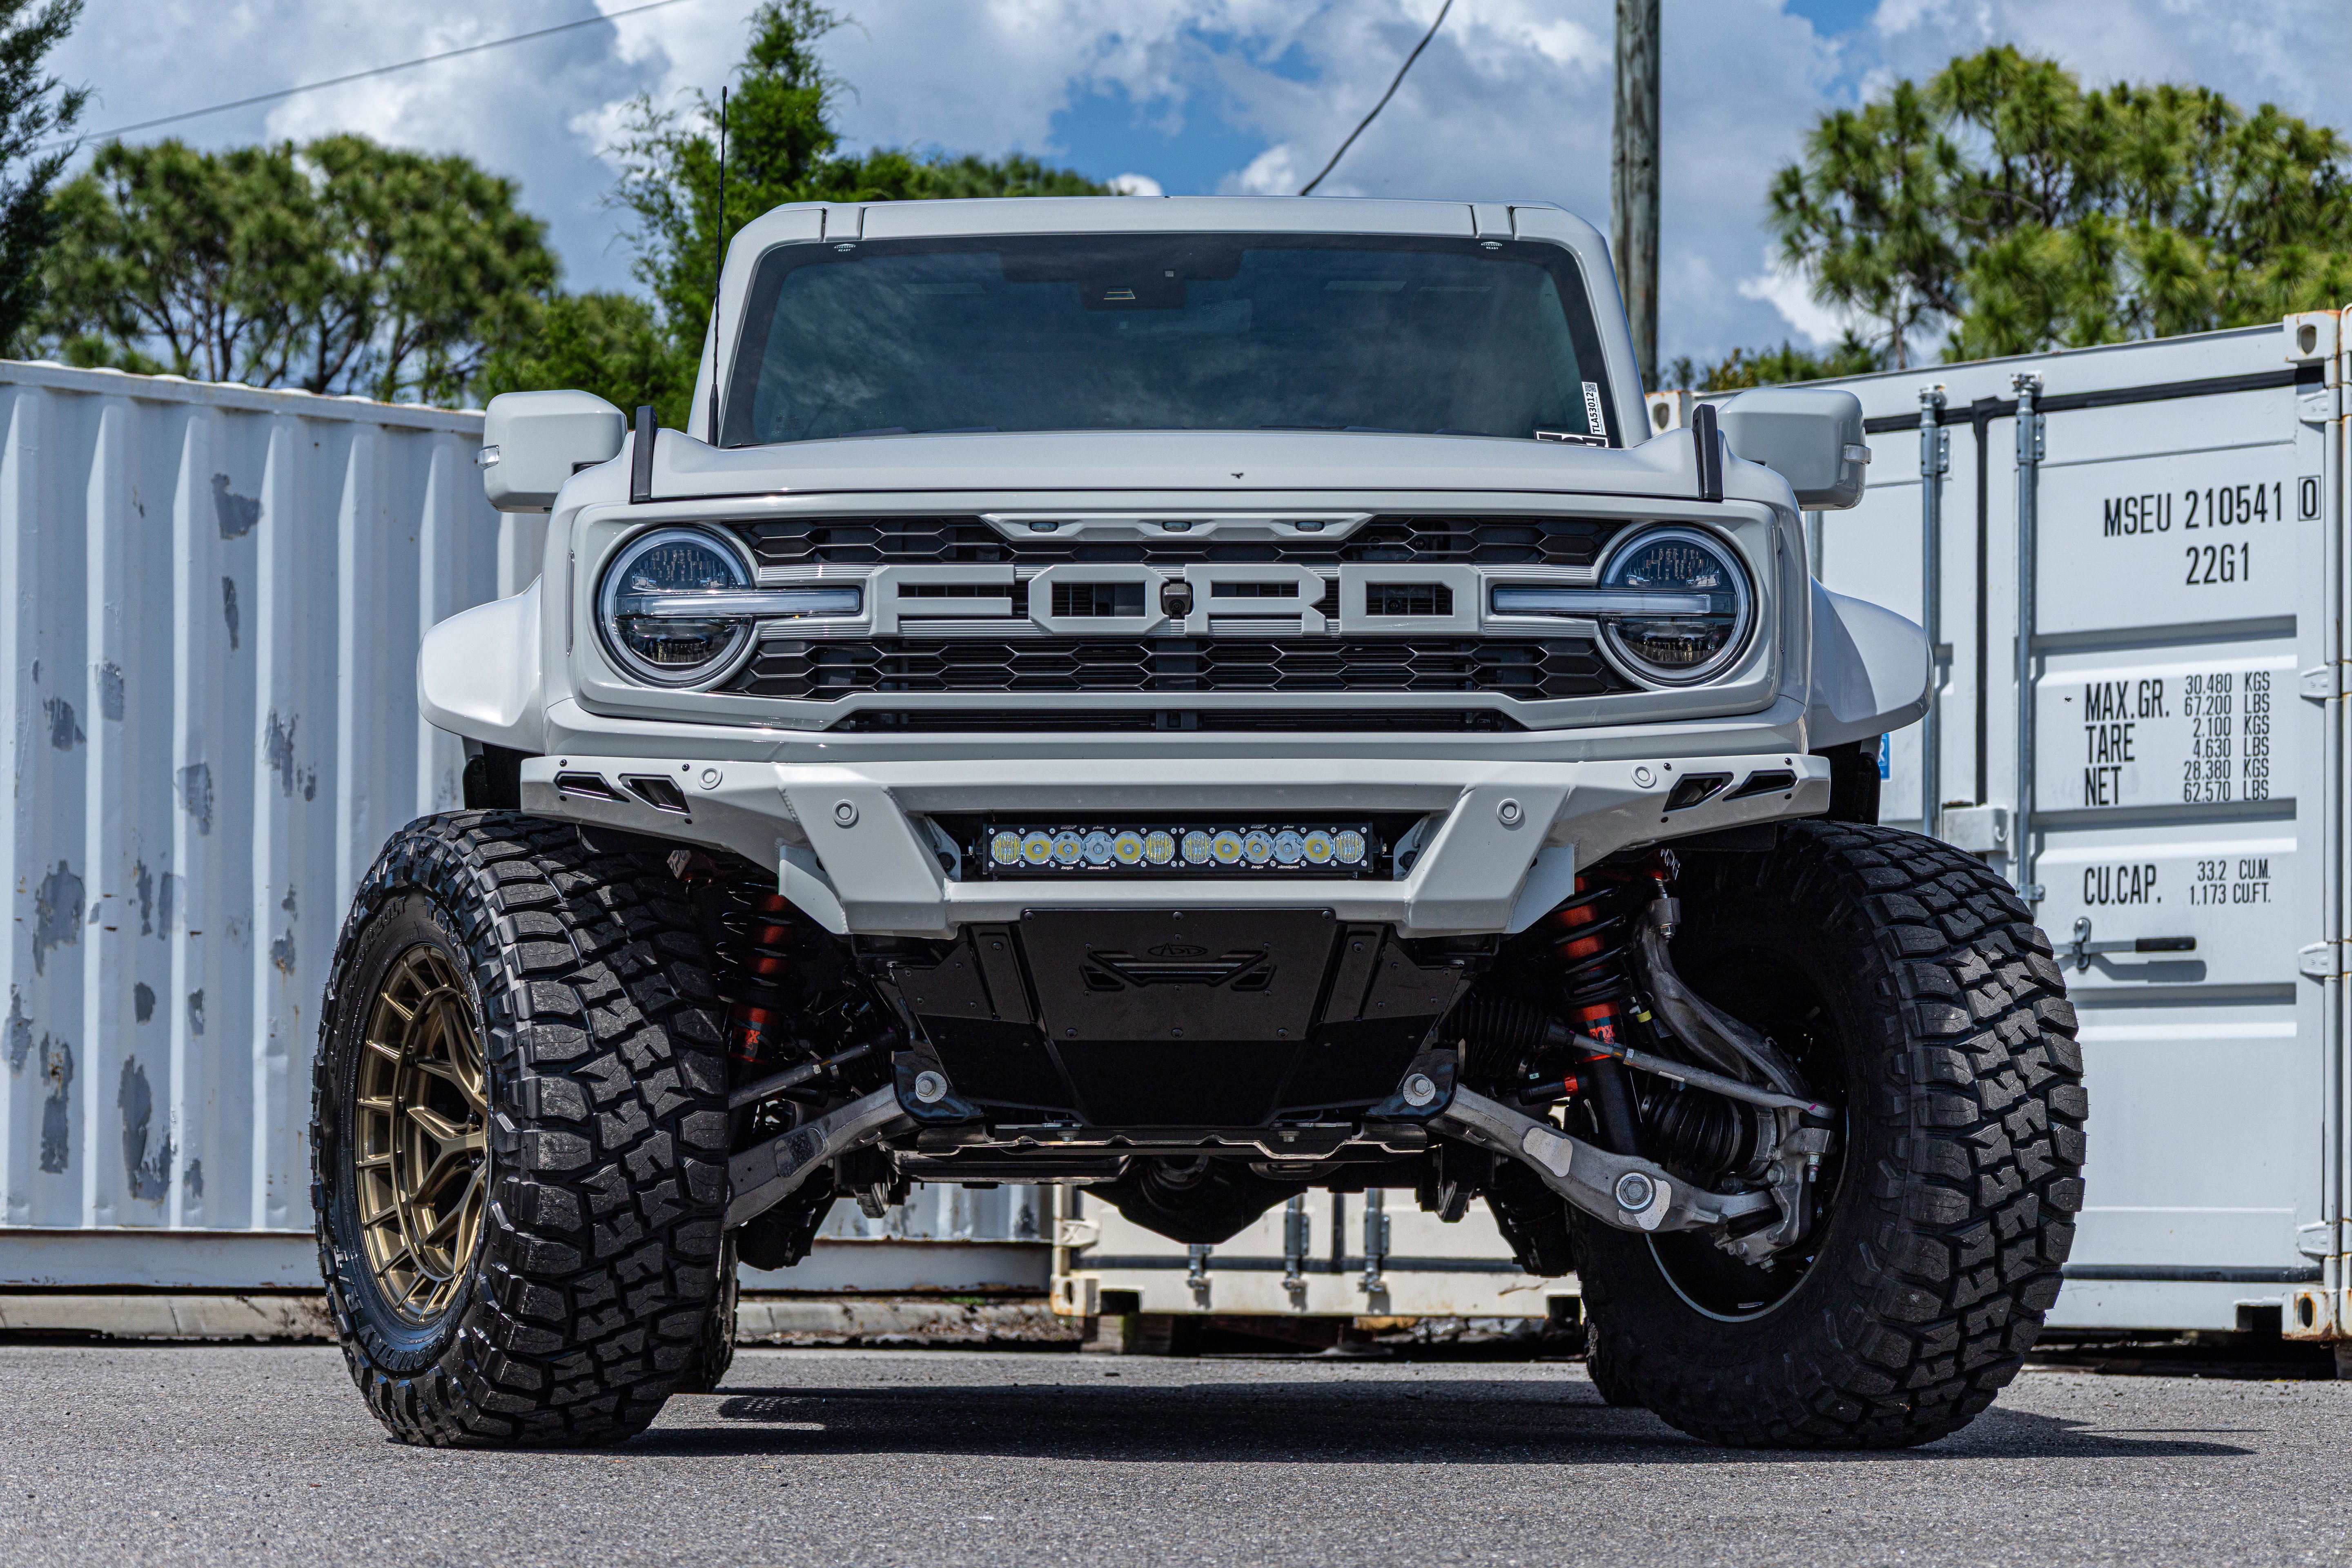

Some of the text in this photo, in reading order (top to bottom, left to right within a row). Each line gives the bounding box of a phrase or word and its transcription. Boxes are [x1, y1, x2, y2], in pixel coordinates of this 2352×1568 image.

[1586, 392, 1600, 433] TLA53012
[2104, 478, 2317, 537] MSEU 210541 0
[2186, 542, 2249, 586] 22G1
[871, 564, 1482, 636] FORD
[2244, 693, 2270, 714] LBS
[2245, 671, 2270, 692] KGS
[2085, 715, 2270, 764] TARE 2,100 KGS
[2244, 736, 2270, 757] LBS
[2085, 766, 2123, 807] NET
[2244, 757, 2270, 778] KGS
[2243, 780, 2269, 801] LBS
[2084, 864, 2161, 906] CU.CAP.
[2197, 860, 2227, 882] 33.2
[425, 896, 470, 974] TOYO
[356, 1324, 441, 1372] COUNTRY
